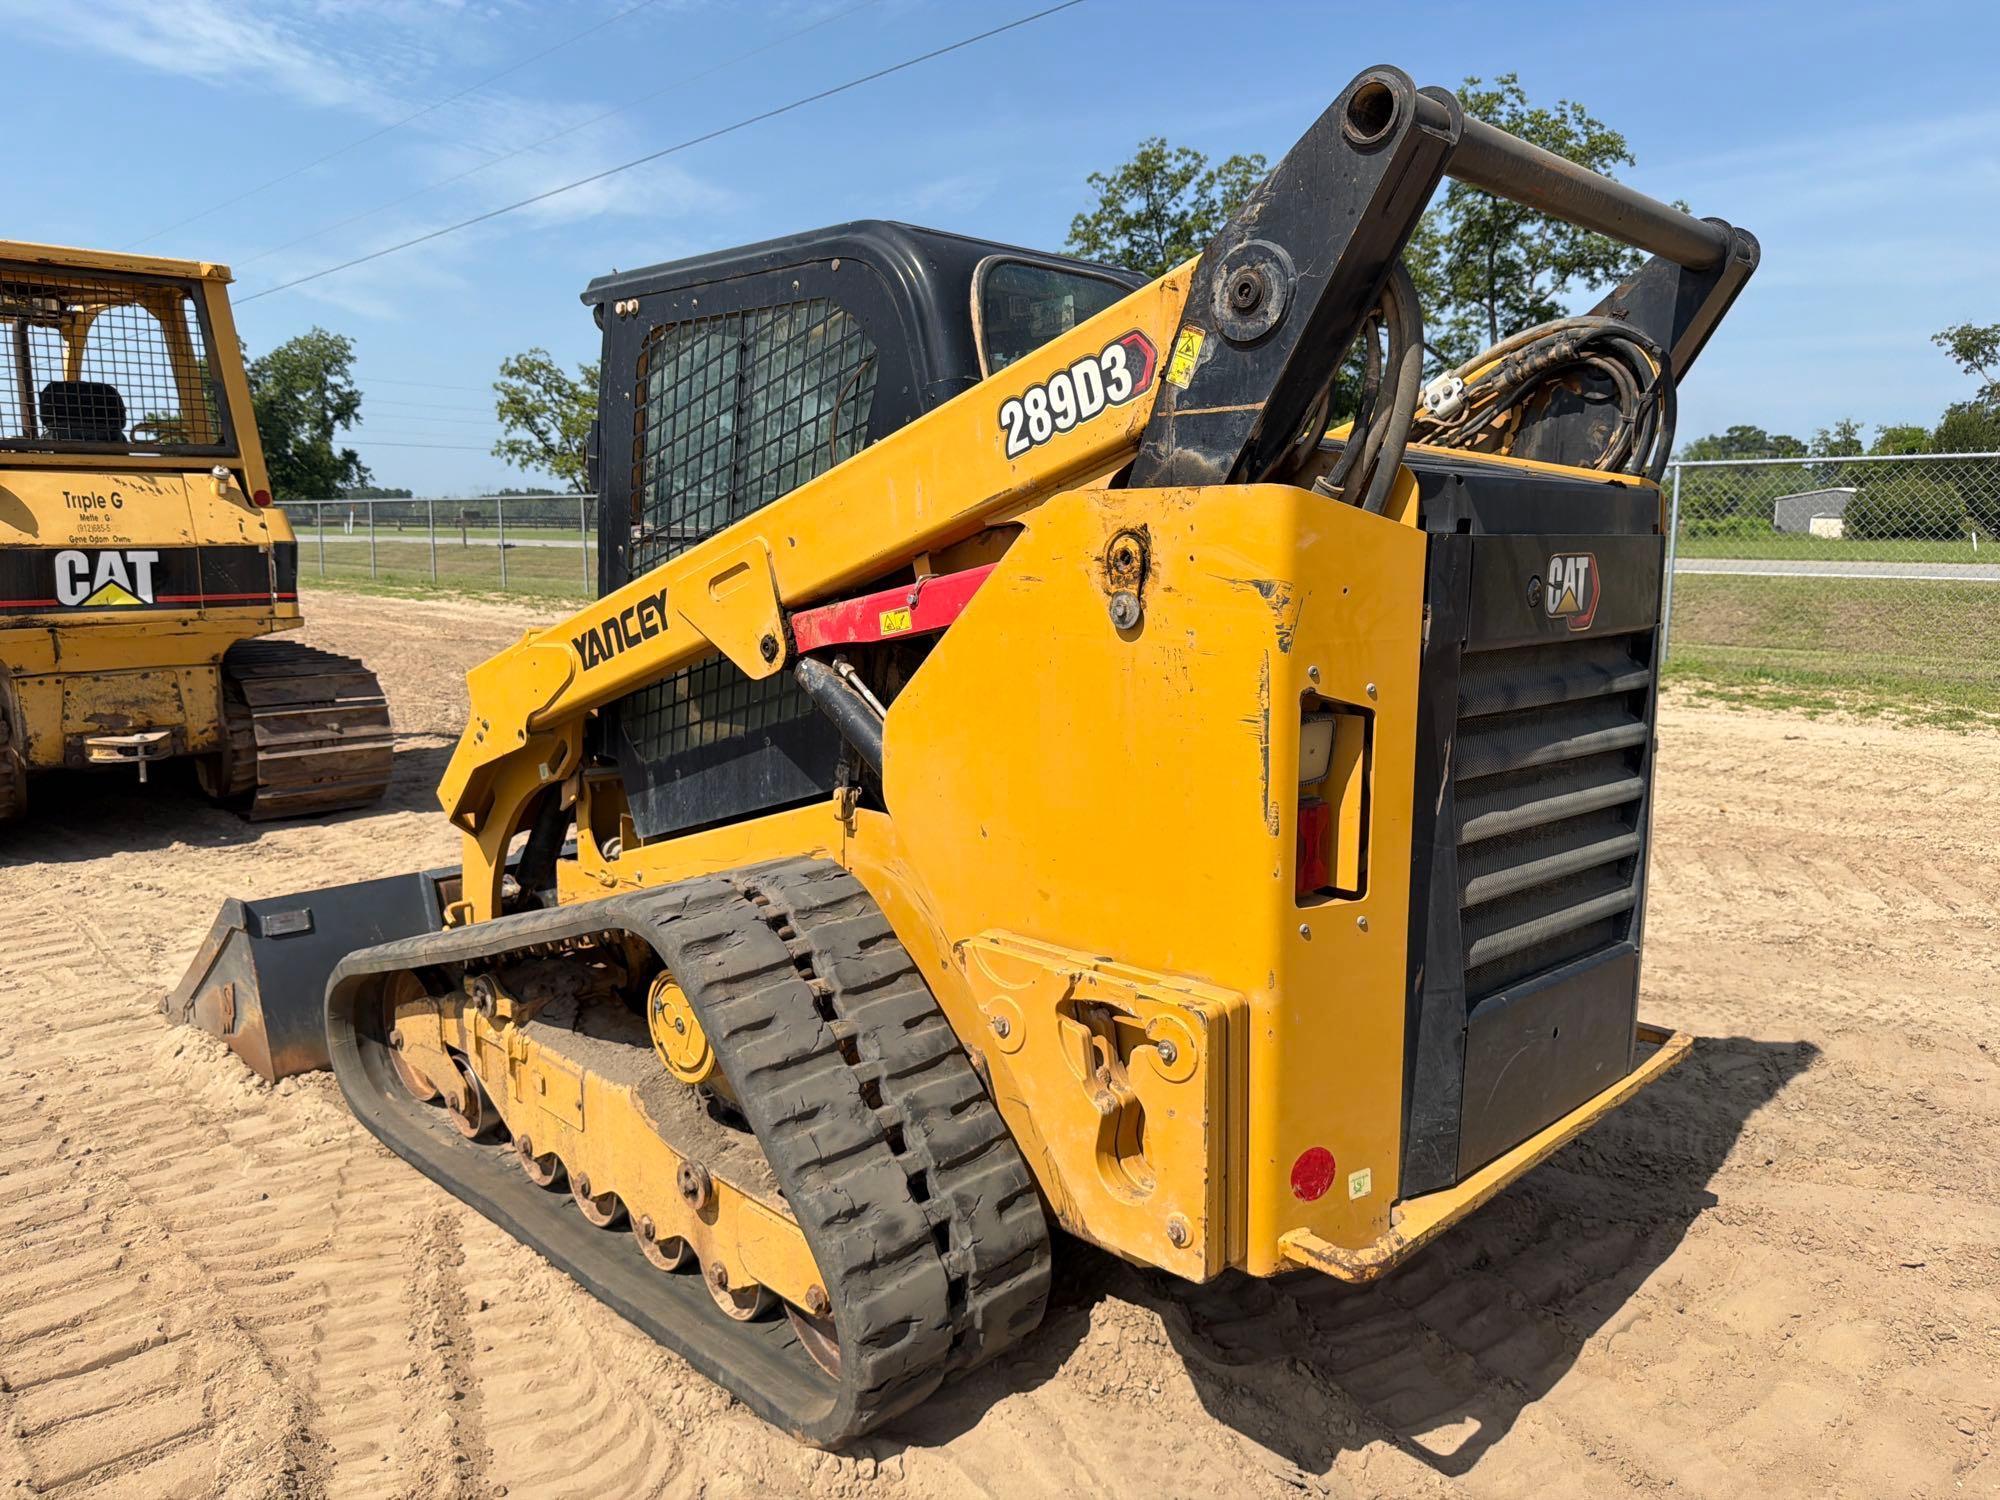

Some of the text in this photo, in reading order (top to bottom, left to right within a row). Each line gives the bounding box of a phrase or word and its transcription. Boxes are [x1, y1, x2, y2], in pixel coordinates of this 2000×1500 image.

[1001, 344, 1132, 455] 289D3
[63, 491, 123, 512] Triple G
[69, 535, 87, 543] Gene
[55, 550, 159, 606] CAT
[1547, 557, 1589, 614] CAT
[571, 588, 668, 671] YANCEY
